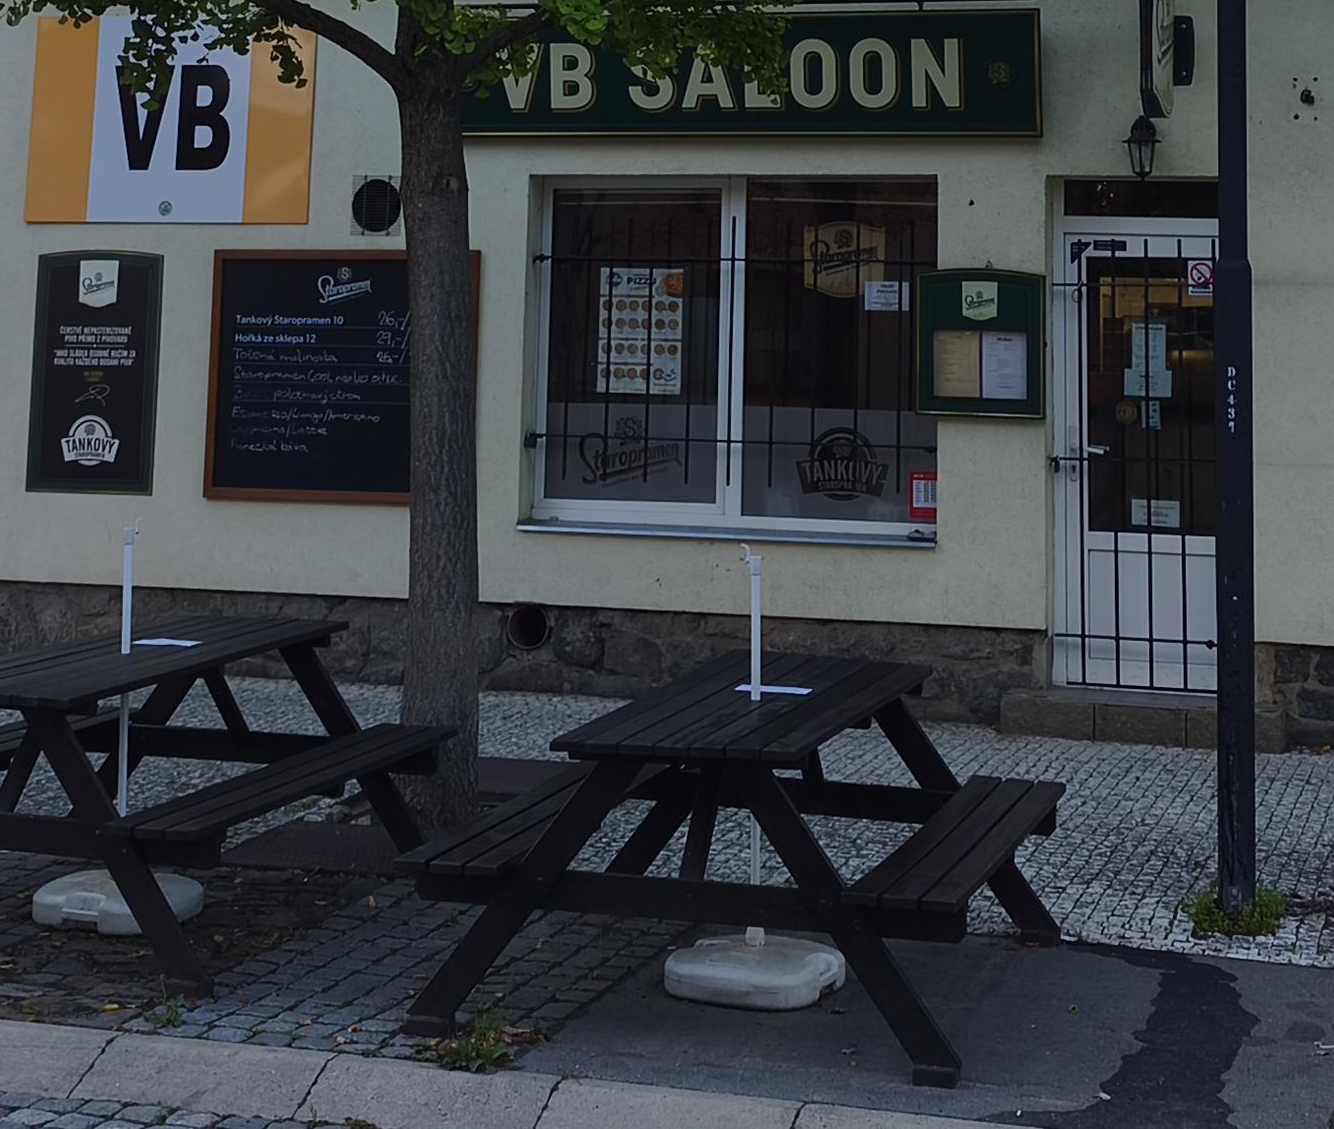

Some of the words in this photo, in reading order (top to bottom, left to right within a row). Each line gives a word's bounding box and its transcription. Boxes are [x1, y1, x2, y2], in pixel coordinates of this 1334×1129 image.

[493, 42, 597, 113] VB
[627, 37, 965, 112] SALOON
[115, 65, 230, 170] VB
[234, 333, 262, 344] Hořká
[263, 335, 274, 344] ze
[275, 333, 304, 346] sklepa
[305, 334, 317, 344] 12
[235, 314, 272, 327] Tankový
[274, 314, 332, 328] Staropramen
[334, 315, 345, 325] 10
